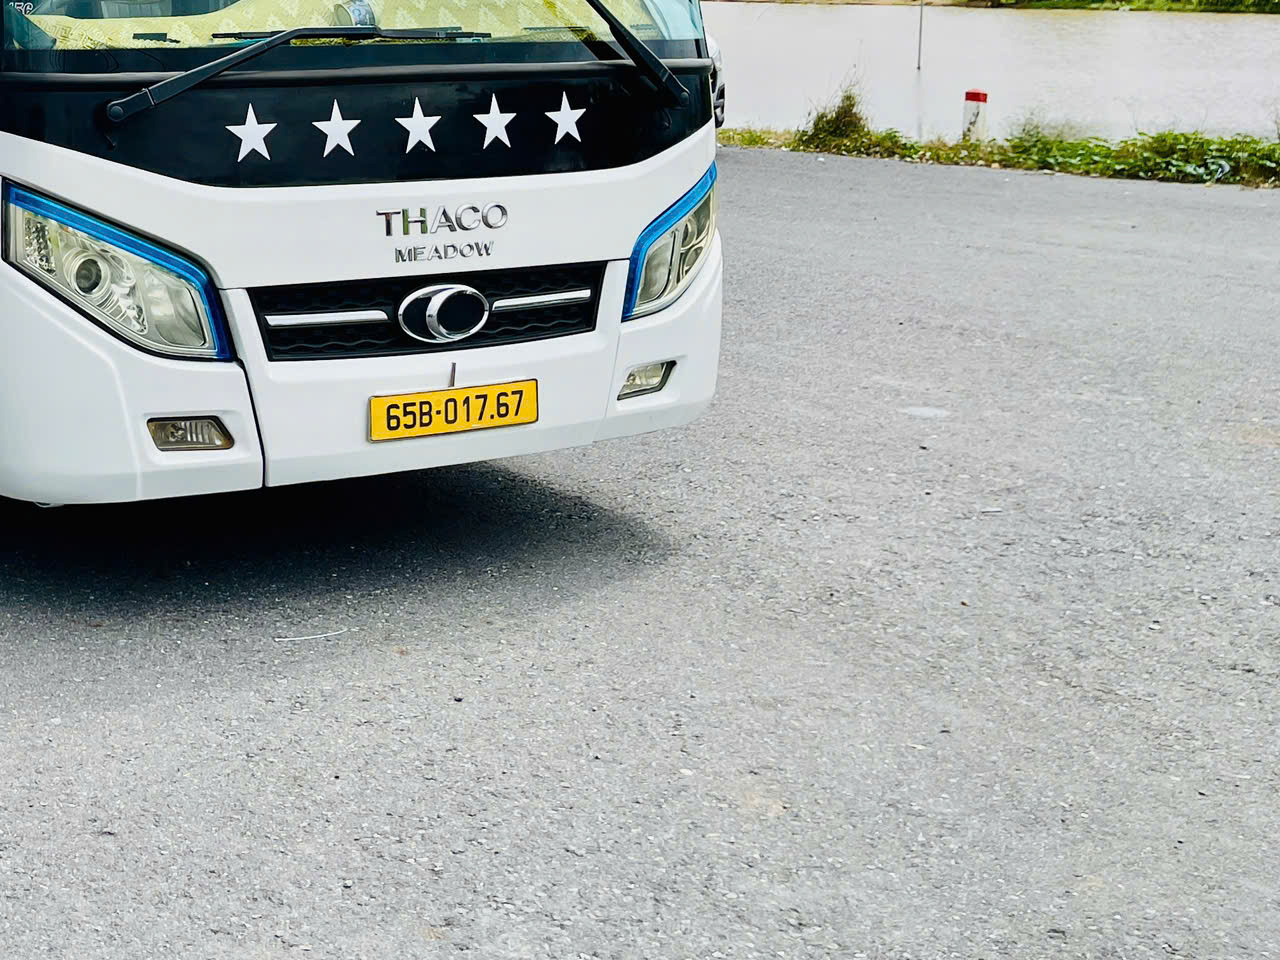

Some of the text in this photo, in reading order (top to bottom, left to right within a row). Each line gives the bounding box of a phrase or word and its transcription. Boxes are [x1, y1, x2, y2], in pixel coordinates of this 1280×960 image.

[375, 203, 509, 238] THACO
[393, 241, 495, 263] MEADOW
[385, 389, 525, 432] 65B-017.67
